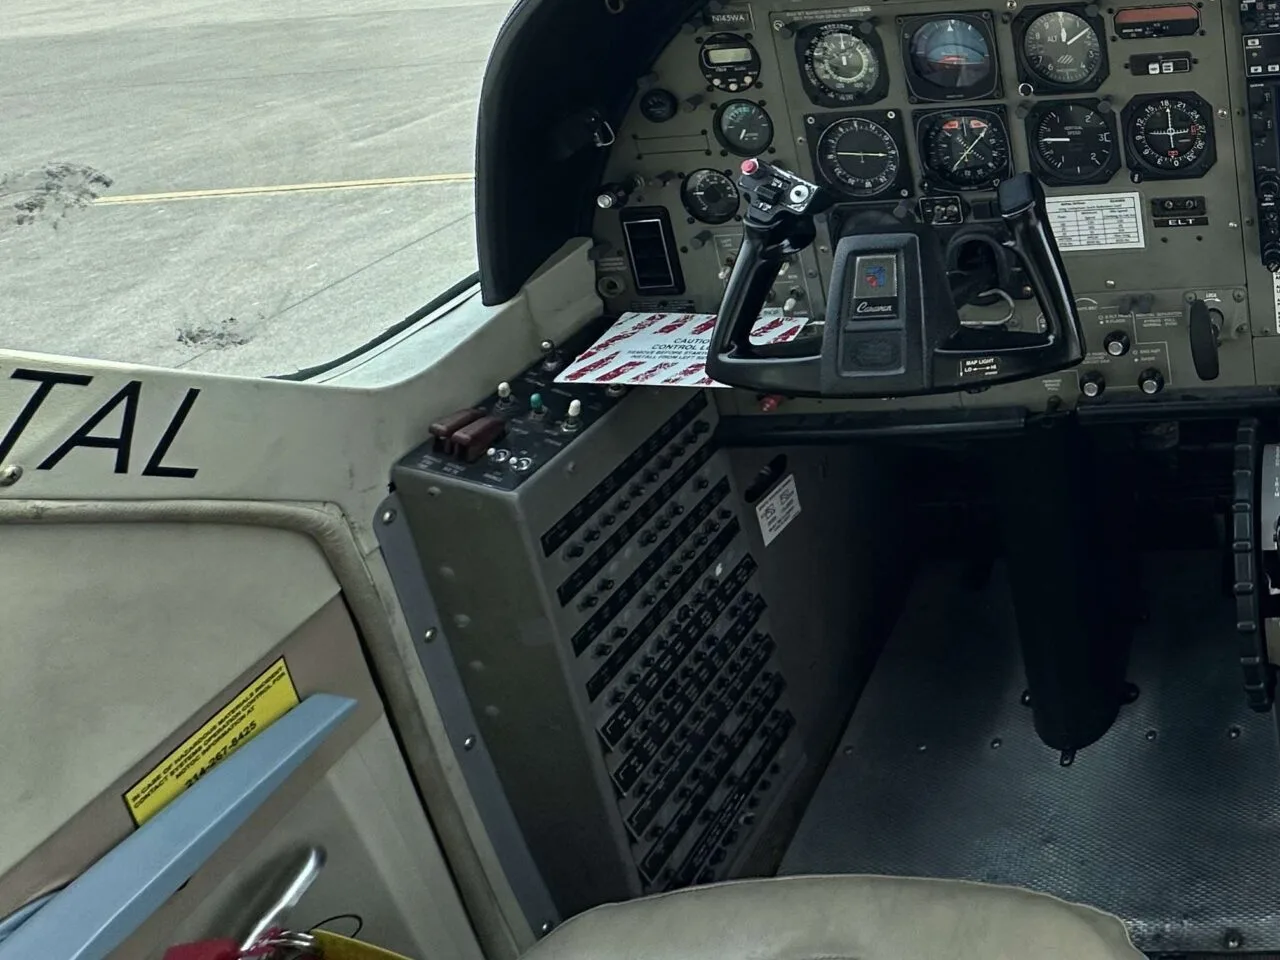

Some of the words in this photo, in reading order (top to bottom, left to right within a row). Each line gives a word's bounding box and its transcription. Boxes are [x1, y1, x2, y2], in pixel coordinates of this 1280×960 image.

[134, 776, 169, 809] CONTACT
[204, 711, 241, 746] OPERATION
[242, 685, 272, 713] CONTROL
[141, 775, 161, 798] CASE
[174, 725, 218, 766] HAZARDOUS
[218, 692, 254, 725] MATERIALS
[255, 666, 283, 693] INCIDENT
[201, 715, 246, 756] INFORMATION
